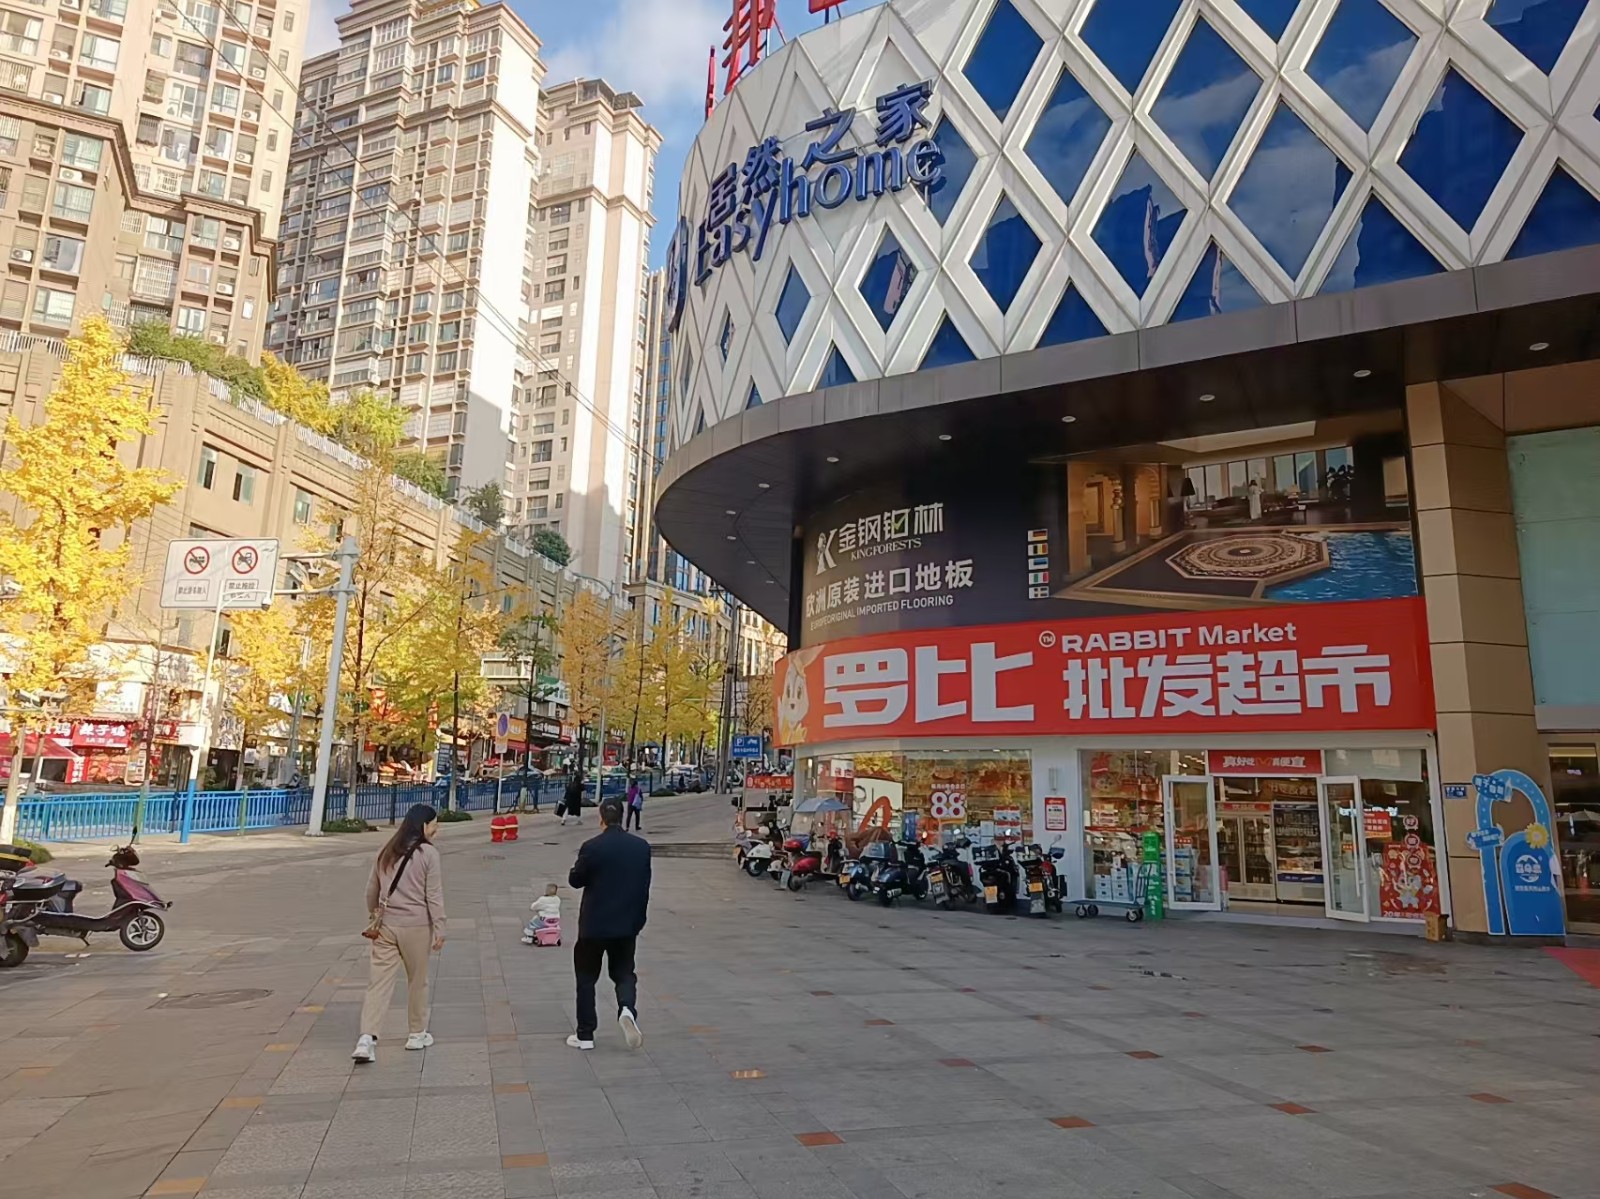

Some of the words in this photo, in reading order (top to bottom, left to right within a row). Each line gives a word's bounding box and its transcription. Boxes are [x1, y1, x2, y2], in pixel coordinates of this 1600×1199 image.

[707, 79, 933, 232] 居然之家
[850, 538, 922, 561] KINGFORESTS
[856, 601, 900, 617] IMPORTED
[900, 594, 954, 610] FLOORING
[1061, 627, 1192, 654] RABBIT
[1198, 622, 1297, 646] Market
[823, 641, 1035, 729] 罗比
[1062, 644, 1392, 721] 批发超市
